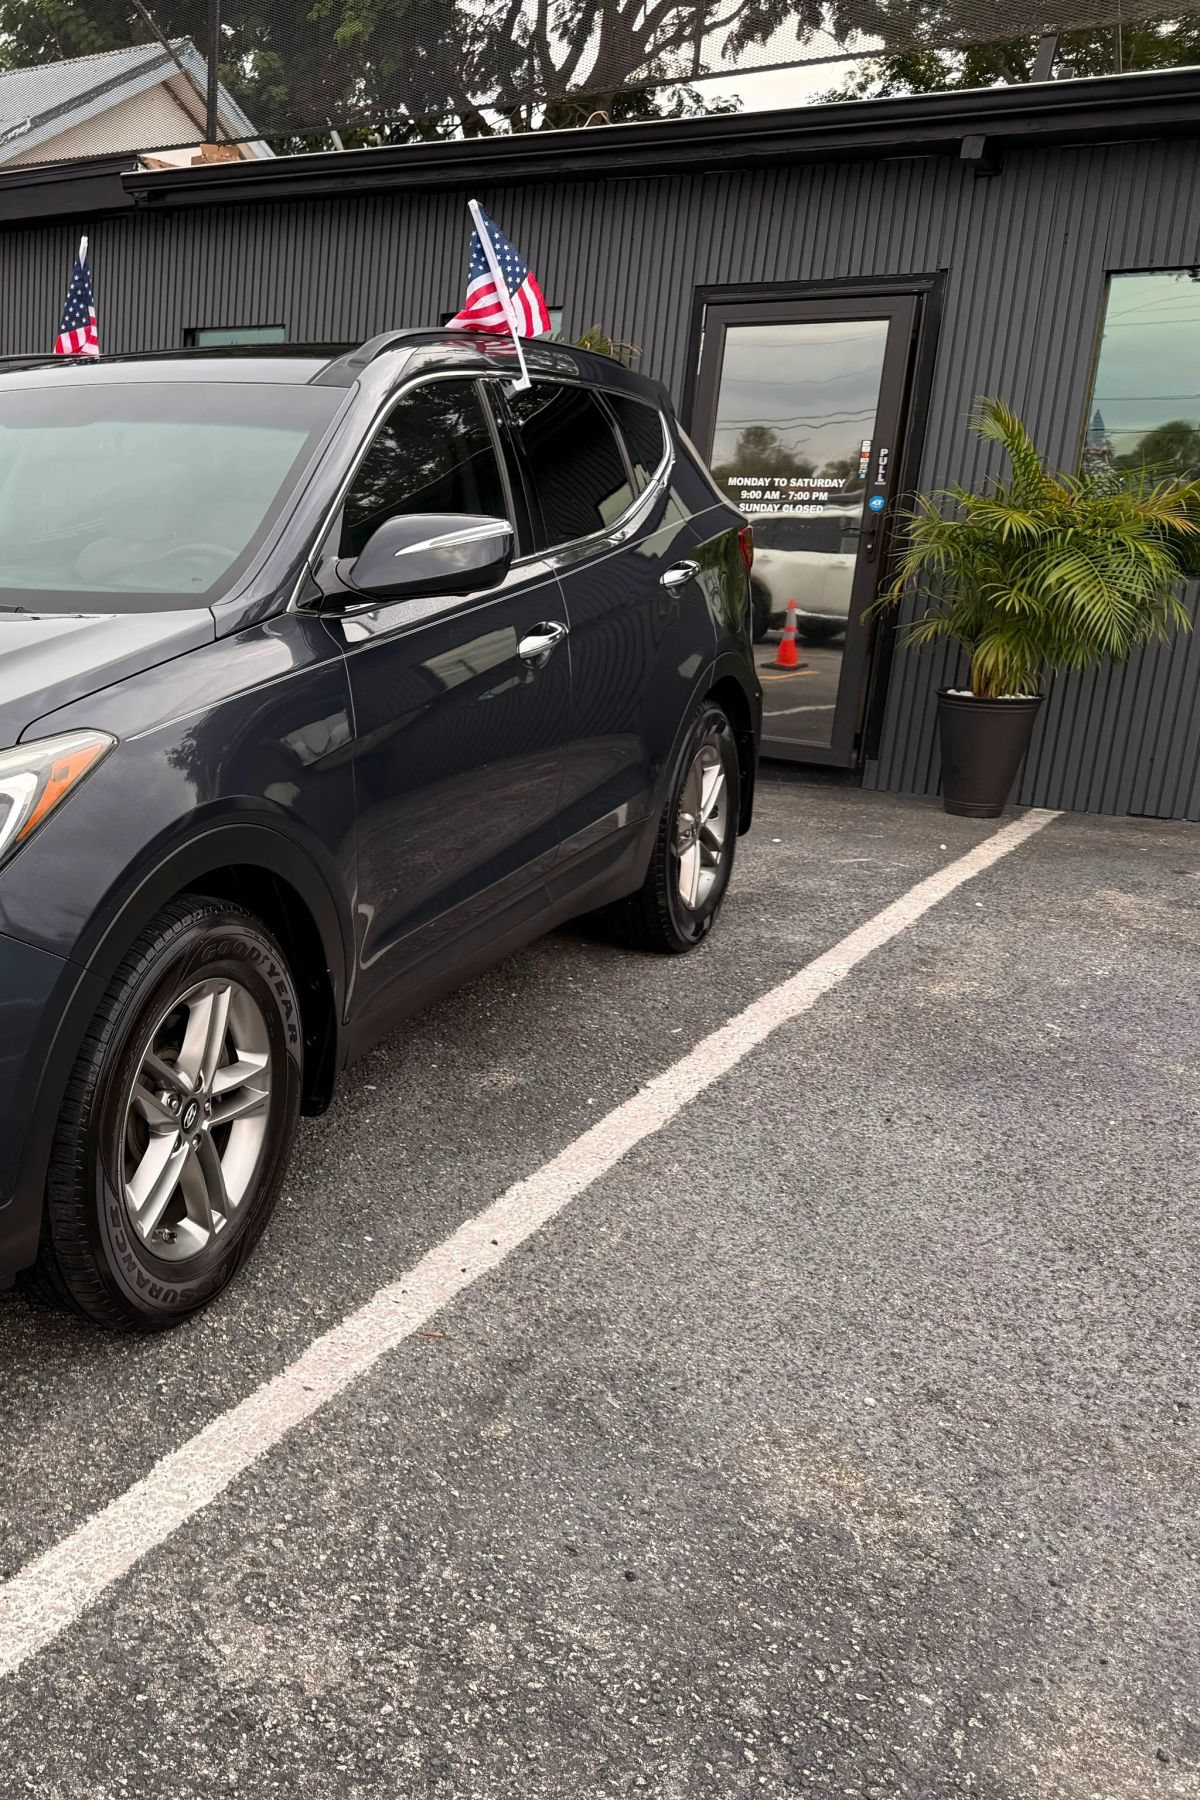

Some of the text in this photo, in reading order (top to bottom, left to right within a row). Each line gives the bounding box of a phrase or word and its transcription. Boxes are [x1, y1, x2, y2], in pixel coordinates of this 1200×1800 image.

[877, 448, 889, 482] PULL
[728, 477, 846, 488] MONDAY TO SATURDAY
[740, 490, 762, 499] 9:00
[764, 491, 780, 500] AM
[788, 491, 811, 500] 7:00
[811, 492, 828, 501] PM
[739, 503, 824, 513] SUNDAY CLOSED
